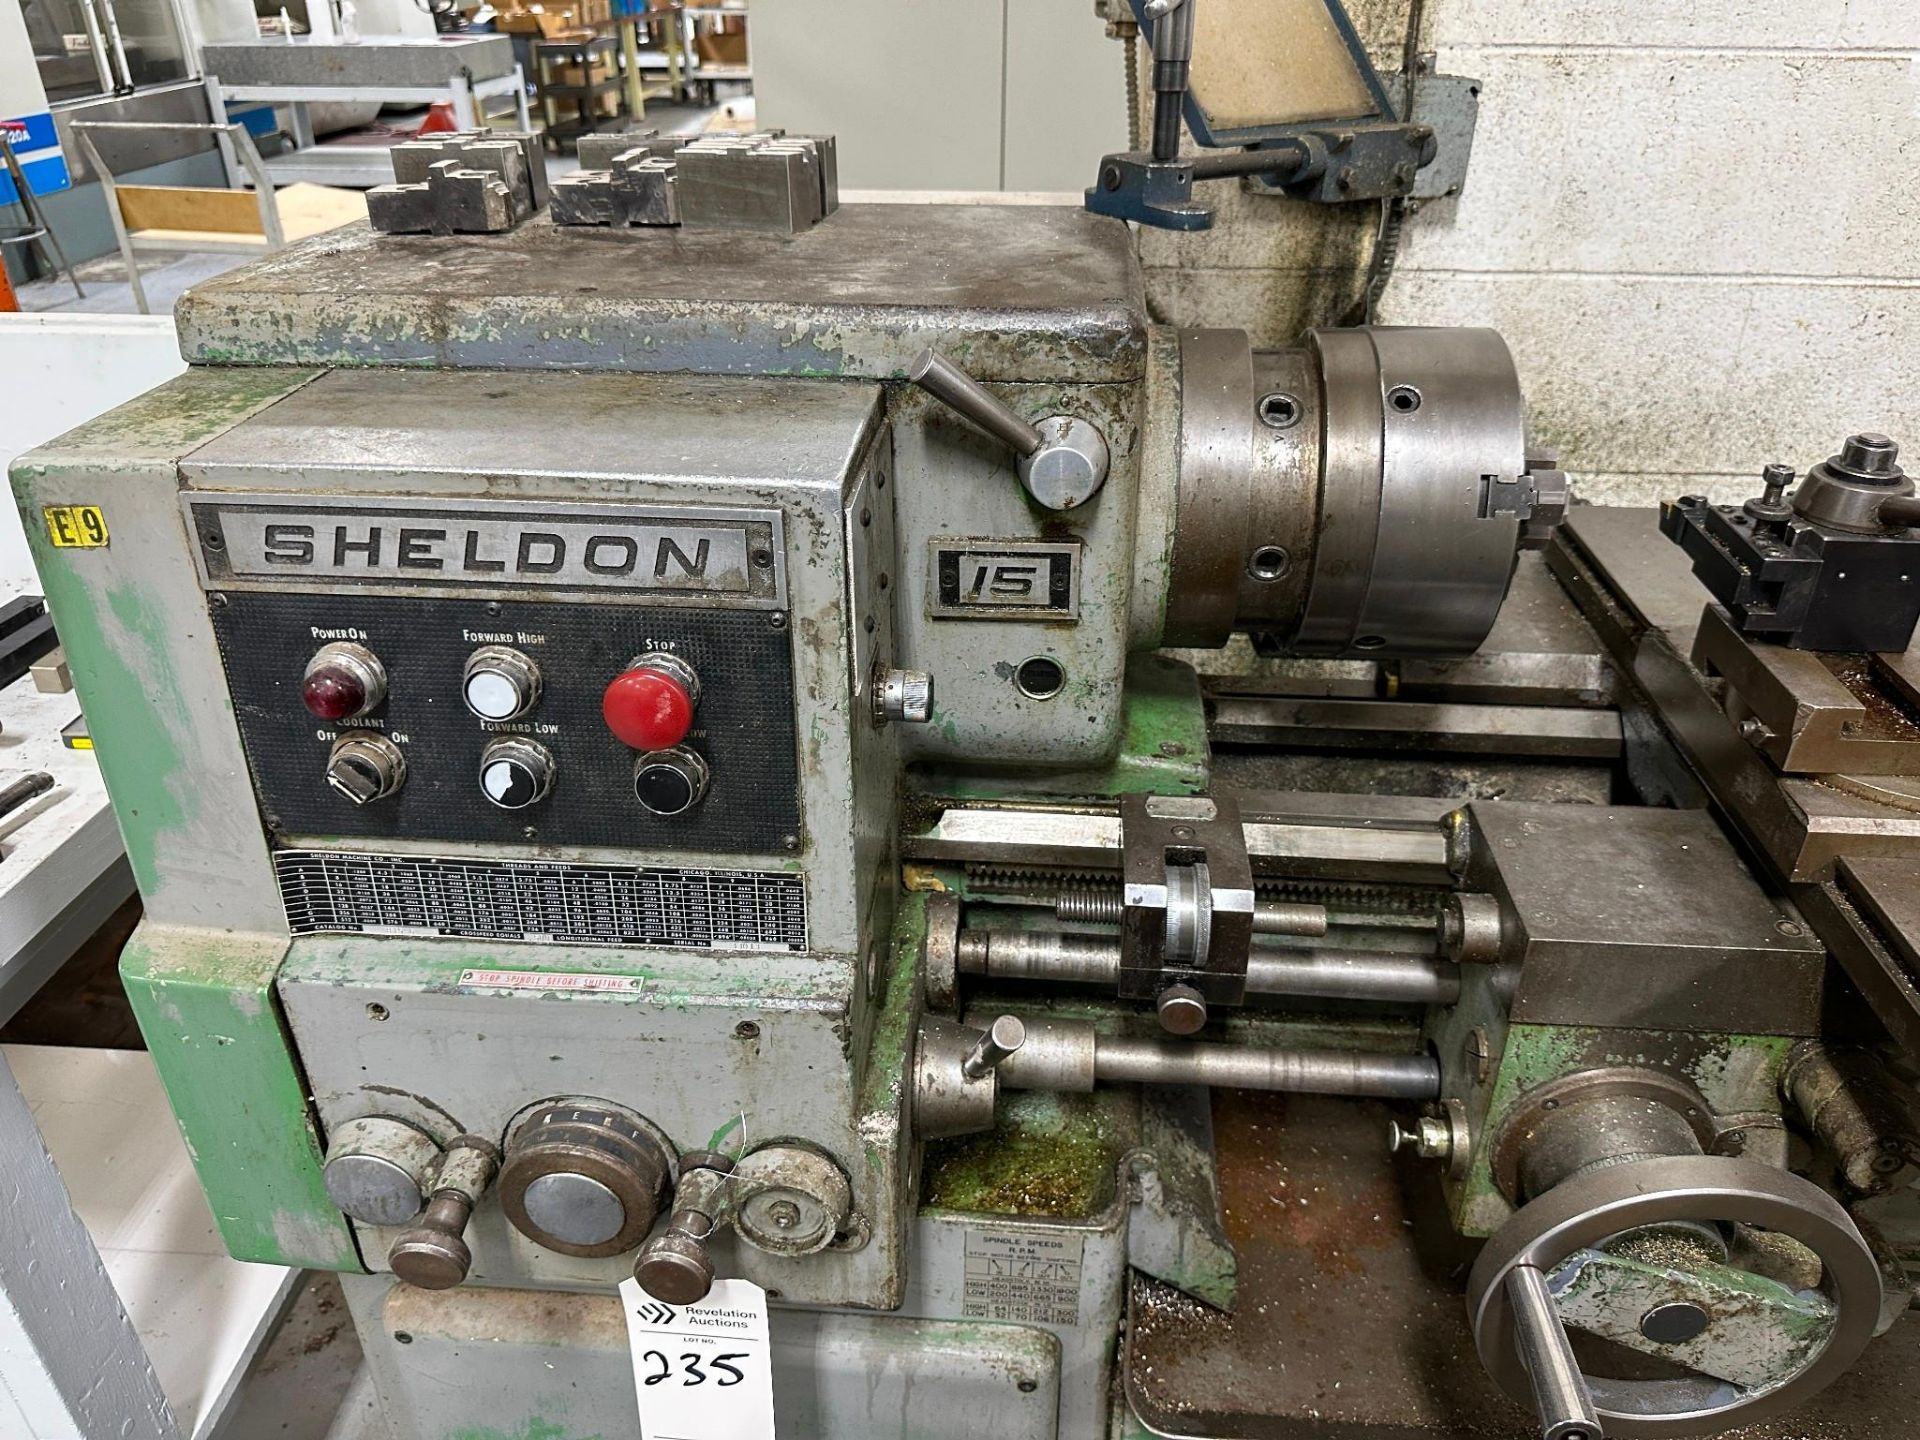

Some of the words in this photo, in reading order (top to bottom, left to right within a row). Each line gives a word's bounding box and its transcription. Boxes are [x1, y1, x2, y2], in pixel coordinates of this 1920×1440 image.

[263, 524, 711, 578] SHELDON
[970, 566, 1038, 597] 15
[517, 631, 545, 644] HIGH
[645, 638, 676, 650] STOP
[535, 722, 559, 734] LOW
[317, 730, 337, 740] OFF
[391, 732, 409, 743] ON
[479, 973, 501, 983] STOP
[505, 974, 541, 985] SPINDLE
[584, 978, 624, 989] SHIFTING
[983, 1236, 1022, 1245] SPINDLE
[1027, 1240, 1064, 1249] SPEEDS
[685, 1306, 757, 1320] Revelation
[688, 1316, 749, 1329] Auctions
[643, 1350, 750, 1387] 235
